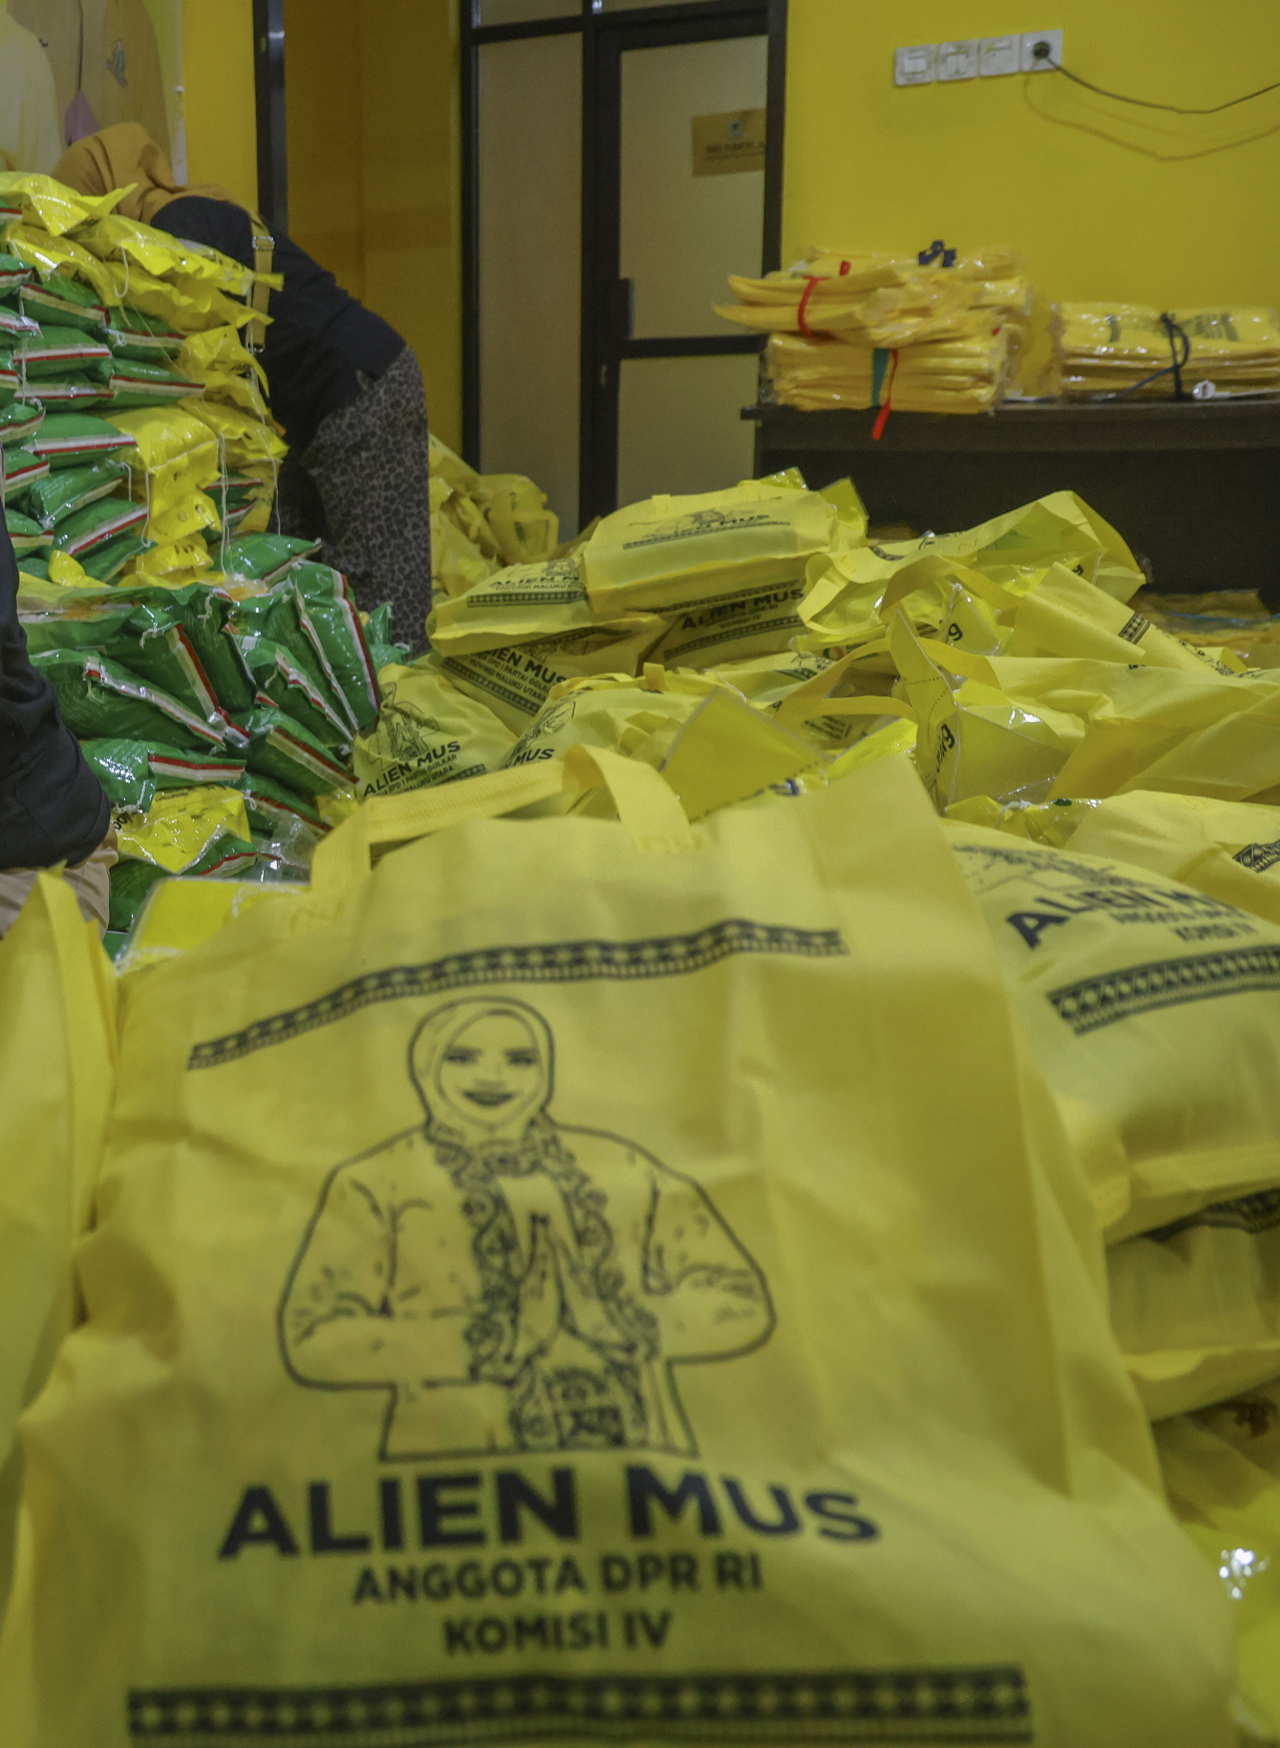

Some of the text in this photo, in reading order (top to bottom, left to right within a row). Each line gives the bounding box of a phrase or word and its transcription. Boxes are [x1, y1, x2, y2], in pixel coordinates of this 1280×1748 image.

[753, 589, 804, 607] MUS
[495, 671, 523, 690] MALUKU
[427, 754, 458, 773] GOLKAR
[513, 748, 556, 767] MUS
[363, 740, 461, 798] ALIEN MUS
[431, 765, 454, 781] UTARA
[217, 1464, 881, 1561] ALIEN MUS
[352, 1550, 763, 1605] ANGGOTA DPR RI
[442, 1609, 673, 1656] KOMISI IV
